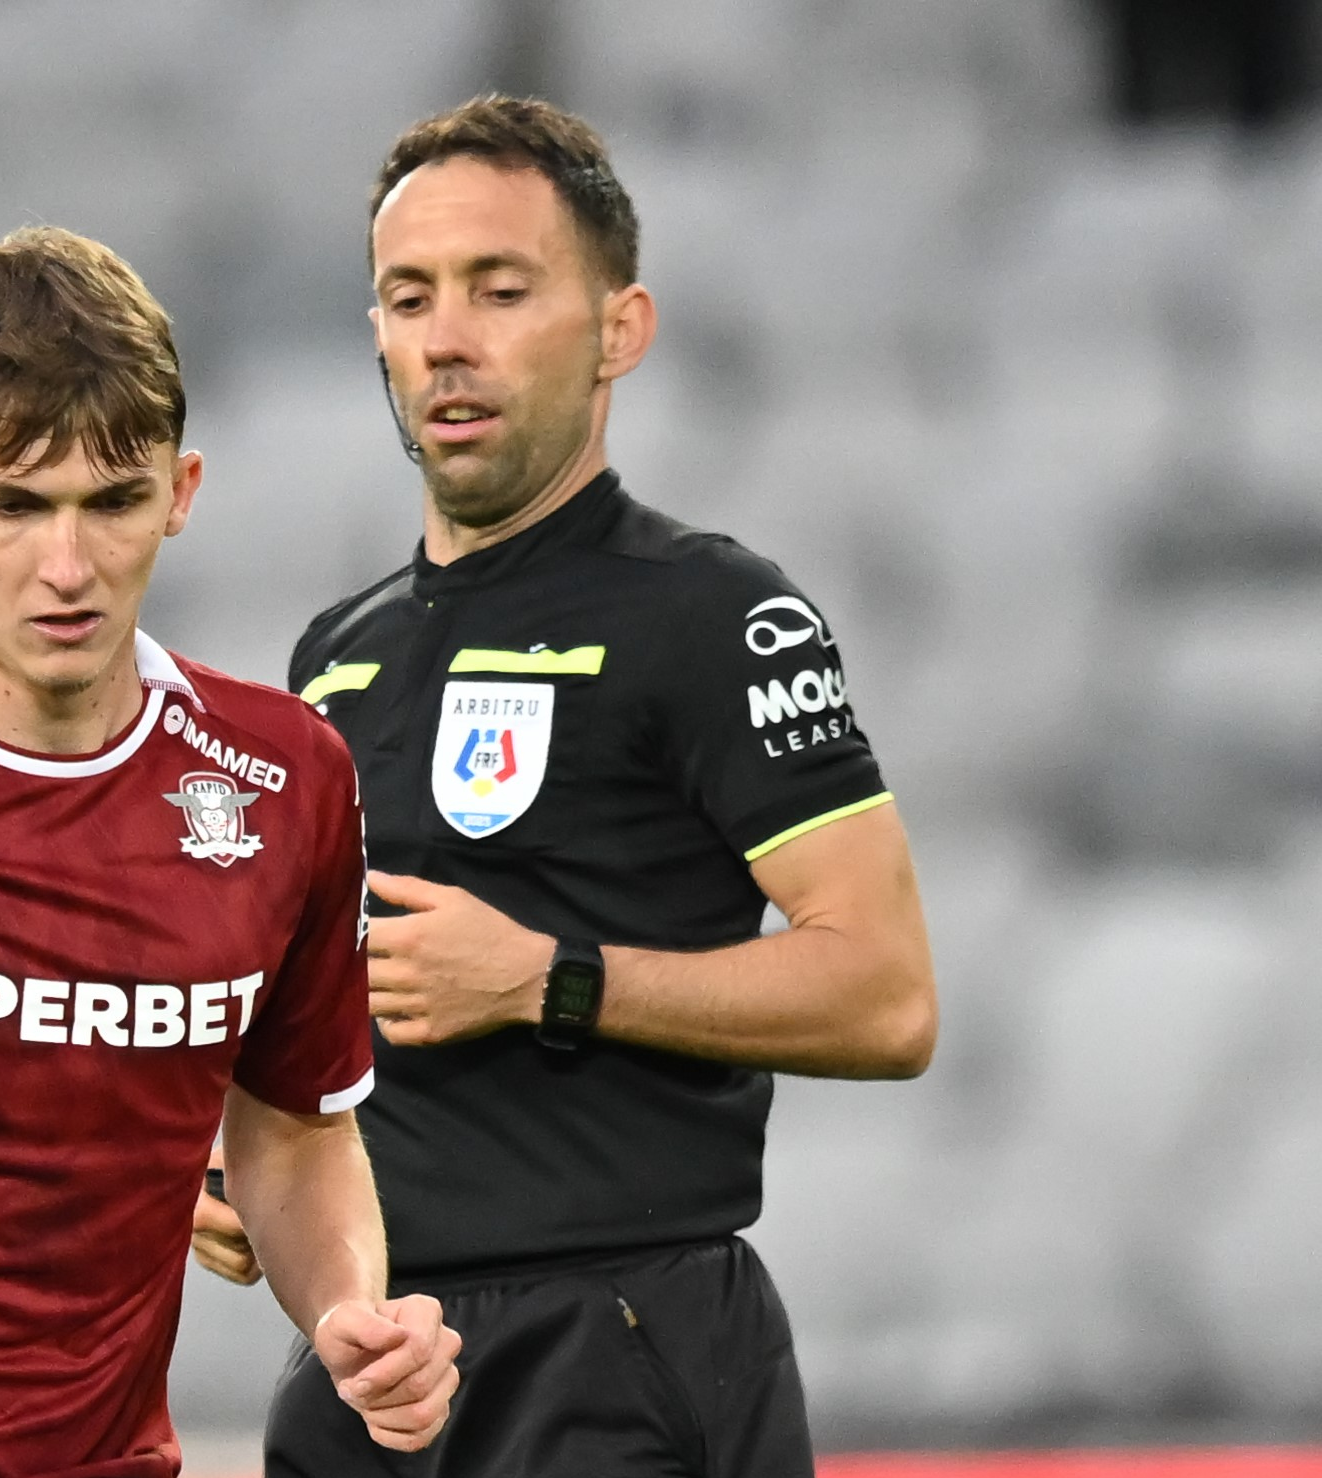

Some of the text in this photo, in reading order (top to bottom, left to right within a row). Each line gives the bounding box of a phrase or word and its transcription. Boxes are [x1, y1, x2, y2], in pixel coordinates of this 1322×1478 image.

[453, 698, 539, 716] ARBITRU
[183, 716, 287, 793] IMAMED
[474, 752, 500, 769] FRF
[192, 783, 226, 795] RAPID
